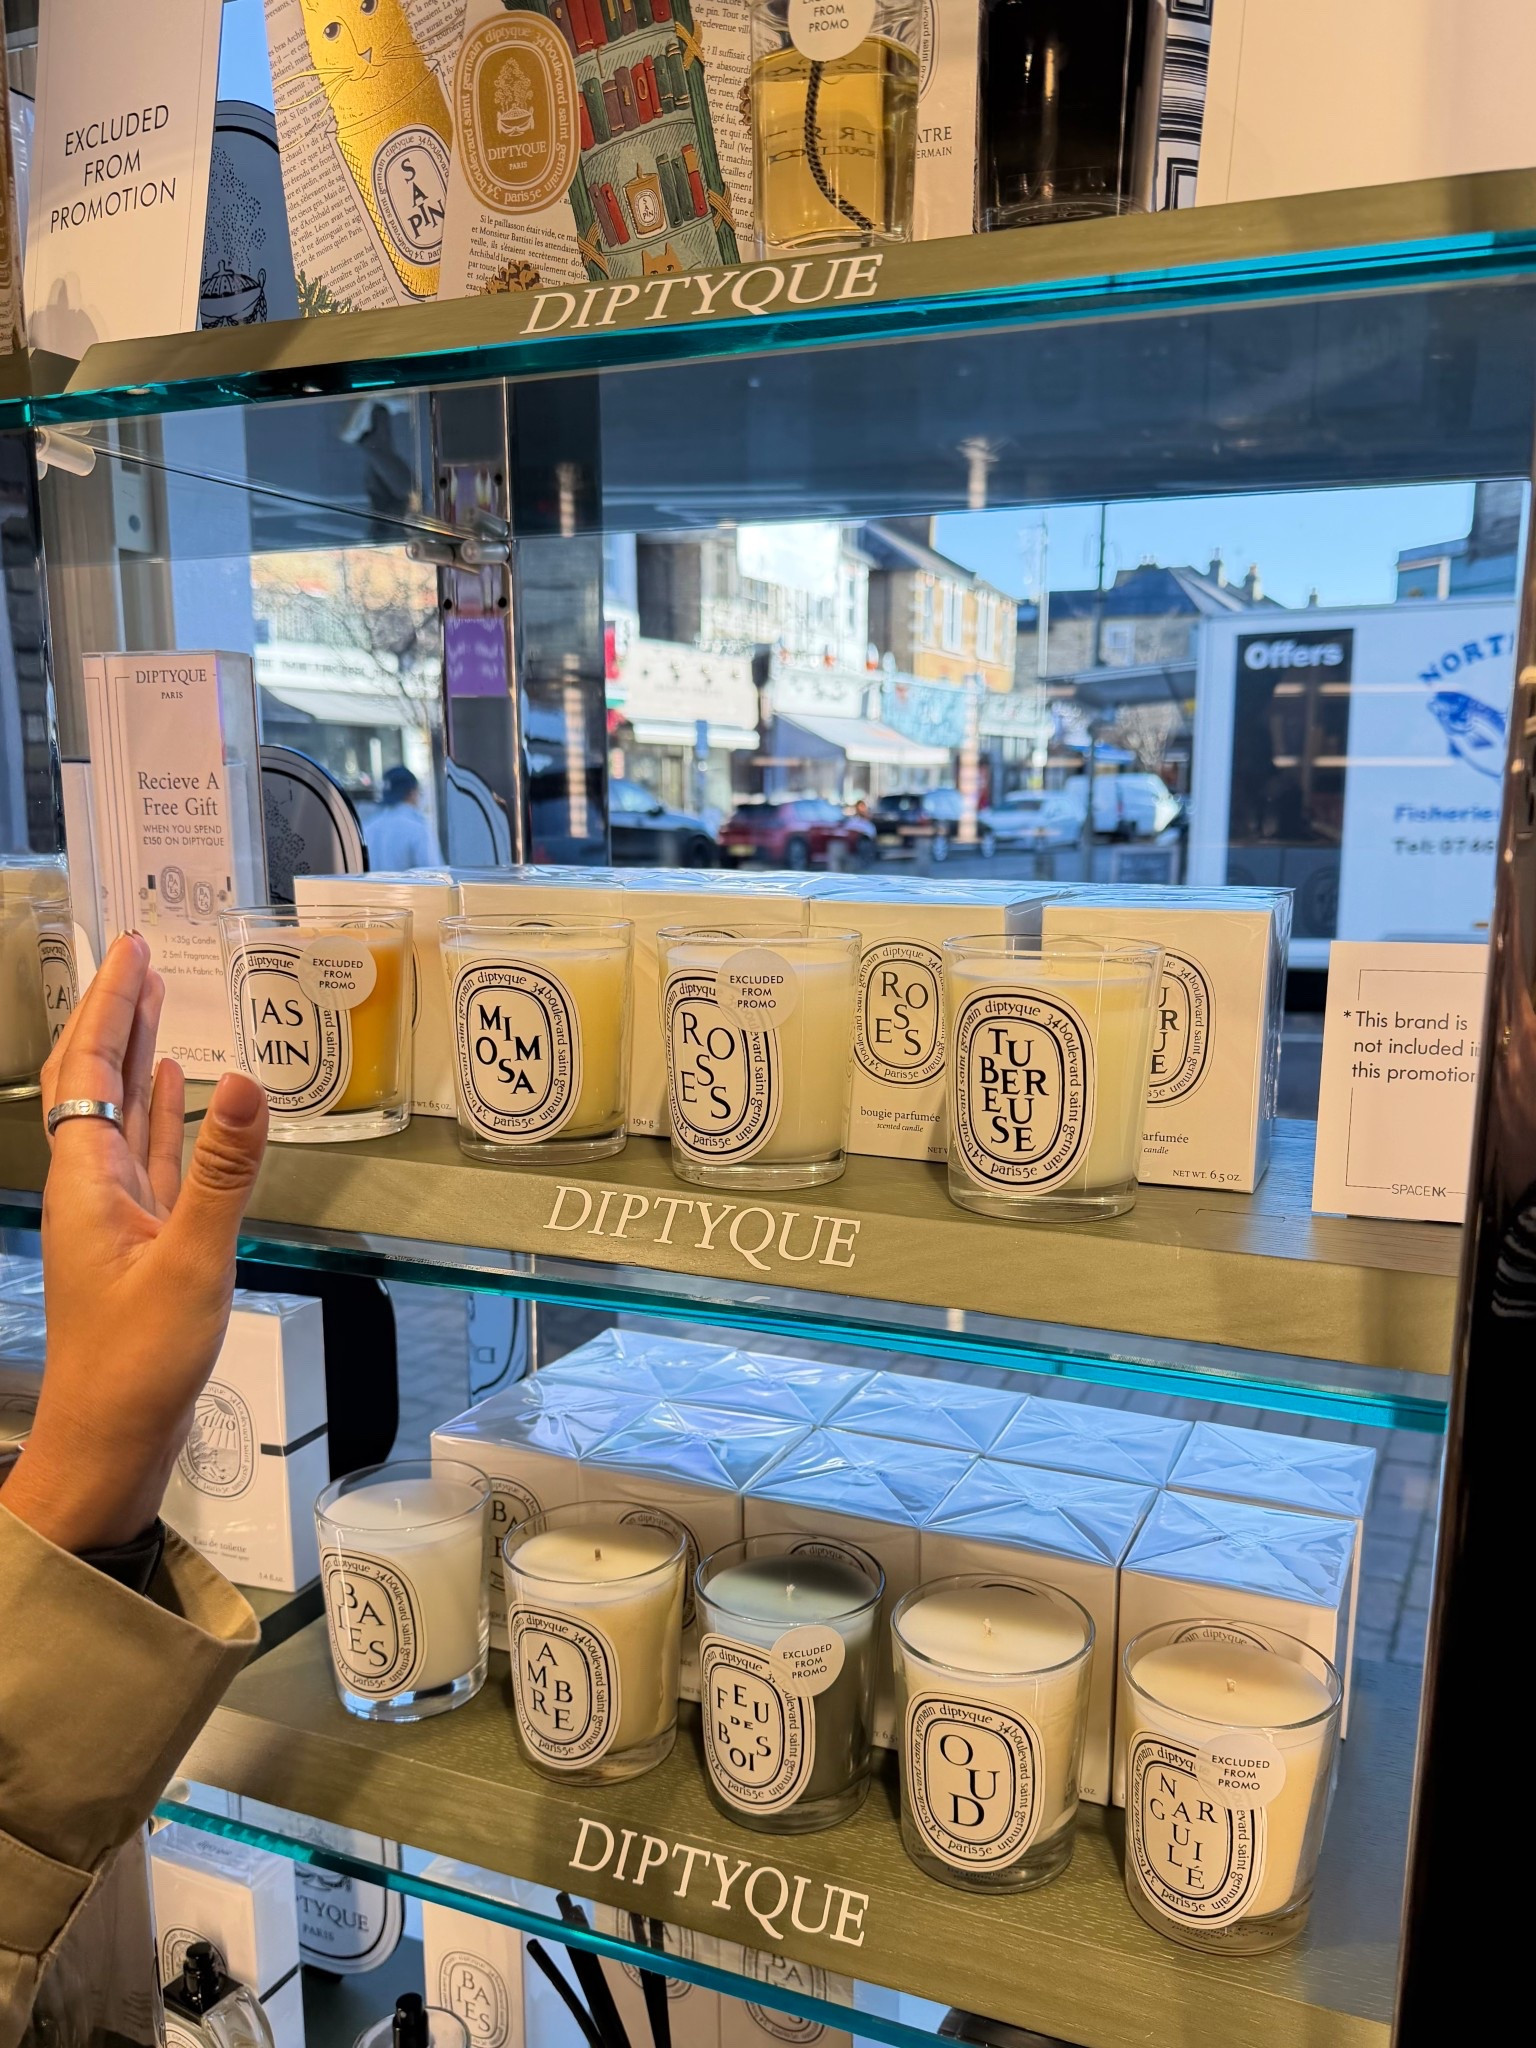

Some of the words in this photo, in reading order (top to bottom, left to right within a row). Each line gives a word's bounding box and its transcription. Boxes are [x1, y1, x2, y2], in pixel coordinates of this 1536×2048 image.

[722, 9, 739, 20] Tout
[814, 5, 844, 16] FROM
[486, 26, 531, 44] diptyque
[809, 19, 849, 32] PROMO
[64, 104, 170, 156] EXCLUDED
[559, 108, 569, 140] saint
[488, 141, 547, 161] DIPTYQUE
[84, 151, 141, 187] FROM
[509, 162, 528, 170] PARIS
[545, 142, 567, 192] germain
[50, 178, 177, 234] PROMOTION
[480, 227, 510, 240] Monsieur
[519, 254, 884, 335] DIPTYQUE
[1244, 640, 1344, 670] Offers
[1419, 633, 1514, 684] NORT
[136, 669, 208, 685] DIPTYQUE
[138, 772, 200, 790] Recieve
[206, 772, 220, 789] A
[143, 798, 178, 815] Free
[185, 797, 218, 816] Gift
[143, 825, 170, 834] WHEN
[171, 825, 191, 834] YOU
[194, 825, 222, 834] SPEND
[143, 836, 162, 845] £150
[165, 837, 179, 846] ON
[181, 837, 225, 847] DIPTYQUE
[184, 951, 219, 961] Fragrances
[248, 956, 294, 970] diptyque
[313, 958, 363, 969] EXCLUDED
[882, 947, 924, 961] diptyque
[324, 970, 352, 979] FROM
[477, 972, 527, 985] diptyque
[730, 976, 784, 984] EXCLUDED
[319, 981, 356, 990] PROMO
[742, 988, 772, 996] FROM
[737, 999, 776, 1009] PROMO
[985, 1000, 1041, 1017] diptyque
[1356, 1010, 1388, 1029] This
[1395, 1011, 1450, 1031] brand
[1456, 1013, 1468, 1031] is
[326, 1031, 335, 1060] saint
[1194, 1030, 1204, 1055] saint
[1354, 1040, 1383, 1054] not
[1389, 1038, 1464, 1057] included
[251, 1039, 310, 1066] MIN
[558, 1049, 567, 1077] saint
[1352, 1063, 1381, 1080] this
[308, 1059, 335, 1100] germain
[755, 1067, 765, 1096] saint
[1170, 1056, 1198, 1093] germain
[539, 1078, 565, 1121] germain
[1069, 1091, 1079, 1122] saint
[735, 1098, 763, 1142] germain
[861, 1106, 892, 1122] bougie
[894, 1110, 941, 1123] parfumée
[877, 1123, 901, 1131] scented
[902, 1124, 924, 1132] candle
[1043, 1124, 1076, 1172] germain
[1173, 1169, 1190, 1178] NET
[543, 1185, 861, 1271] DIPTYQUE
[333, 1557, 371, 1574] diptyque
[401, 1620, 412, 1647] saint
[527, 1614, 568, 1634] diptyque
[719, 1649, 763, 1672] diptyque
[783, 1644, 832, 1660] EXCLUDED
[390, 1647, 412, 1682] germain
[795, 1657, 823, 1668] FROM
[792, 1666, 827, 1679] PROMO
[596, 1689, 606, 1713] saint
[730, 1715, 754, 1730] DE
[939, 1704, 993, 1724] diptyque
[578, 1714, 604, 1752] germain
[789, 1731, 798, 1758] saint
[1212, 1754, 1270, 1769] EXCLUDED
[768, 1759, 797, 1797] germain
[1224, 1768, 1257, 1779] FROM
[1218, 1778, 1260, 1790] PROMO
[1020, 1782, 1030, 1810] saint
[997, 1810, 1026, 1851] germain
[1237, 1843, 1247, 1871] saint
[568, 1817, 869, 1948] DIPTYQUE
[1211, 1871, 1244, 1912] germain
[303, 1924, 334, 1941] PARIS
